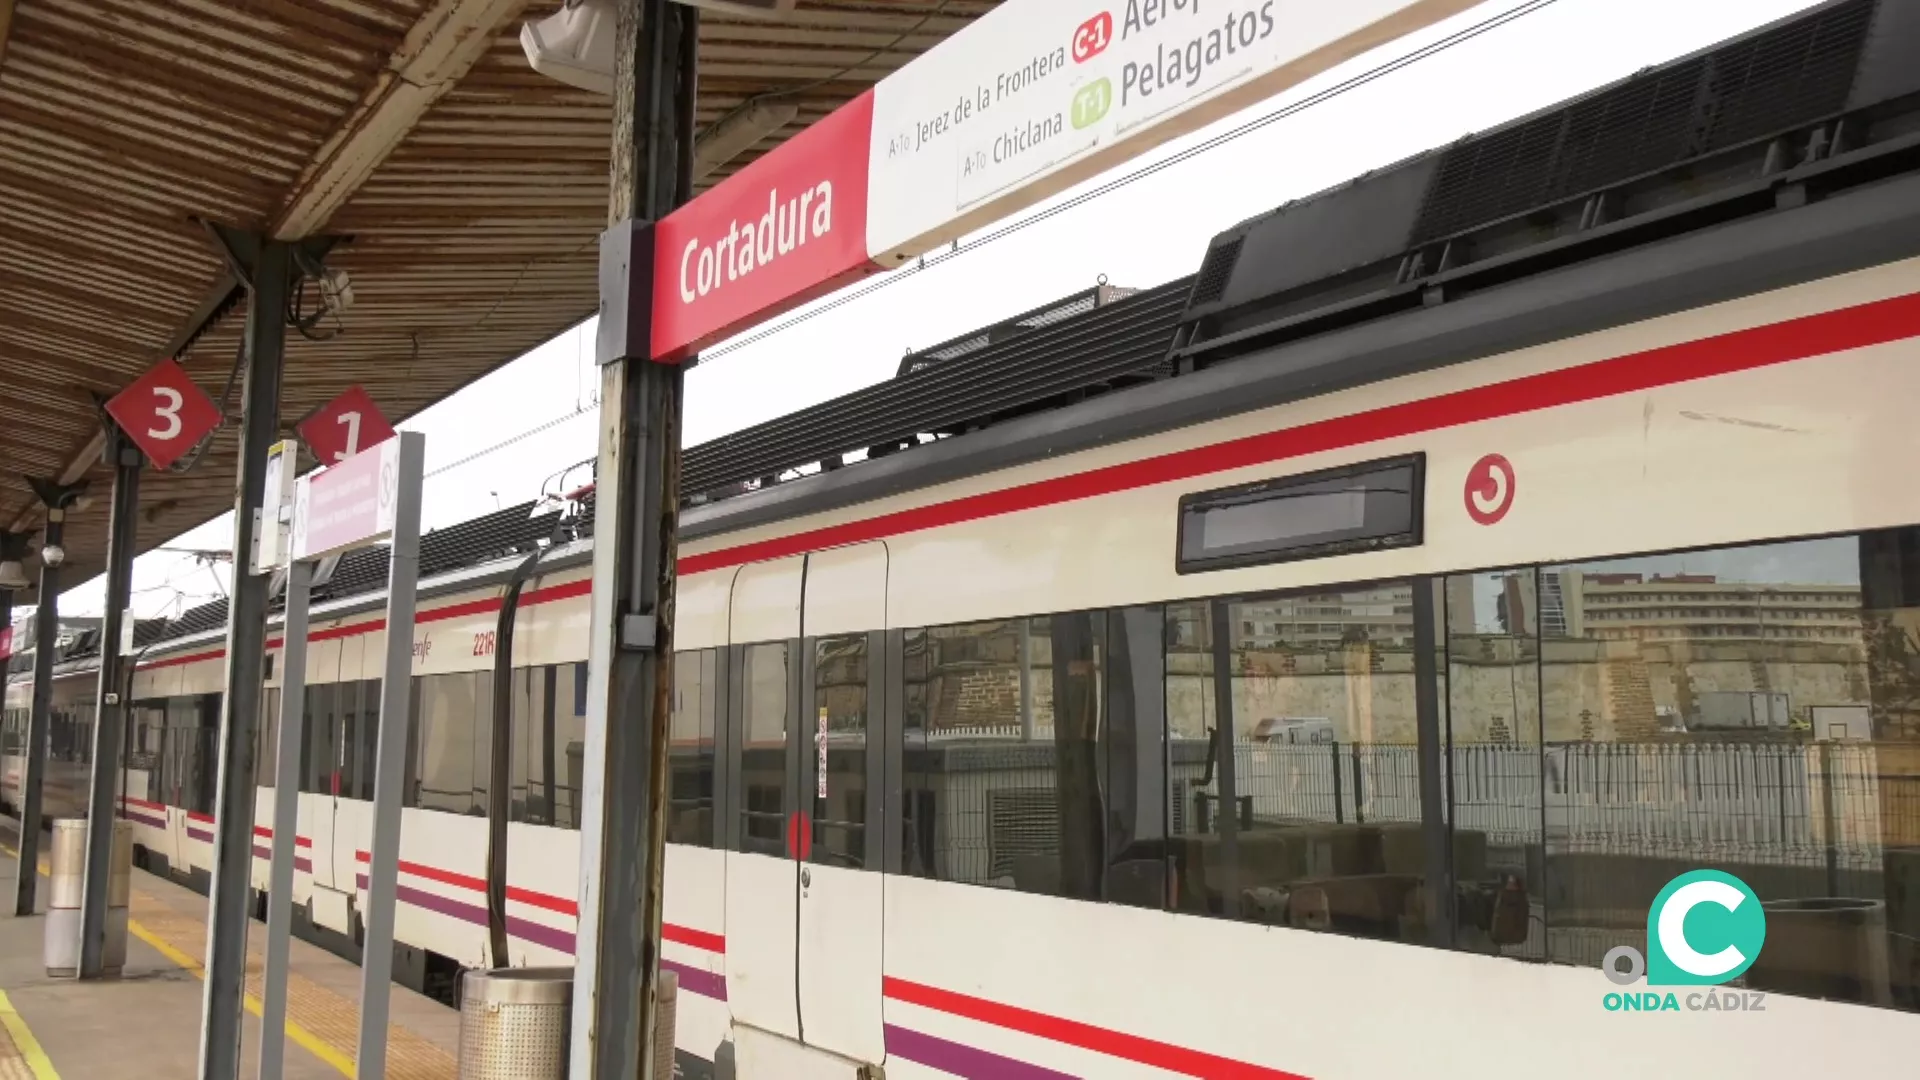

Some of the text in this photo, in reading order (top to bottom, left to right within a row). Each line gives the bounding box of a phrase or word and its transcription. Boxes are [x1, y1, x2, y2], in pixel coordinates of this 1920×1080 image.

[1075, 18, 1107, 58] C-1
[1122, 0, 1274, 107] Pelagatos
[916, 110, 949, 152] Jerez
[954, 97, 971, 125] de
[977, 85, 990, 112] la
[996, 47, 1064, 102] Frontera
[993, 112, 1062, 164] Chiclana
[680, 180, 832, 304] Cortadura
[147, 386, 184, 440] 3
[333, 410, 361, 461] 1
